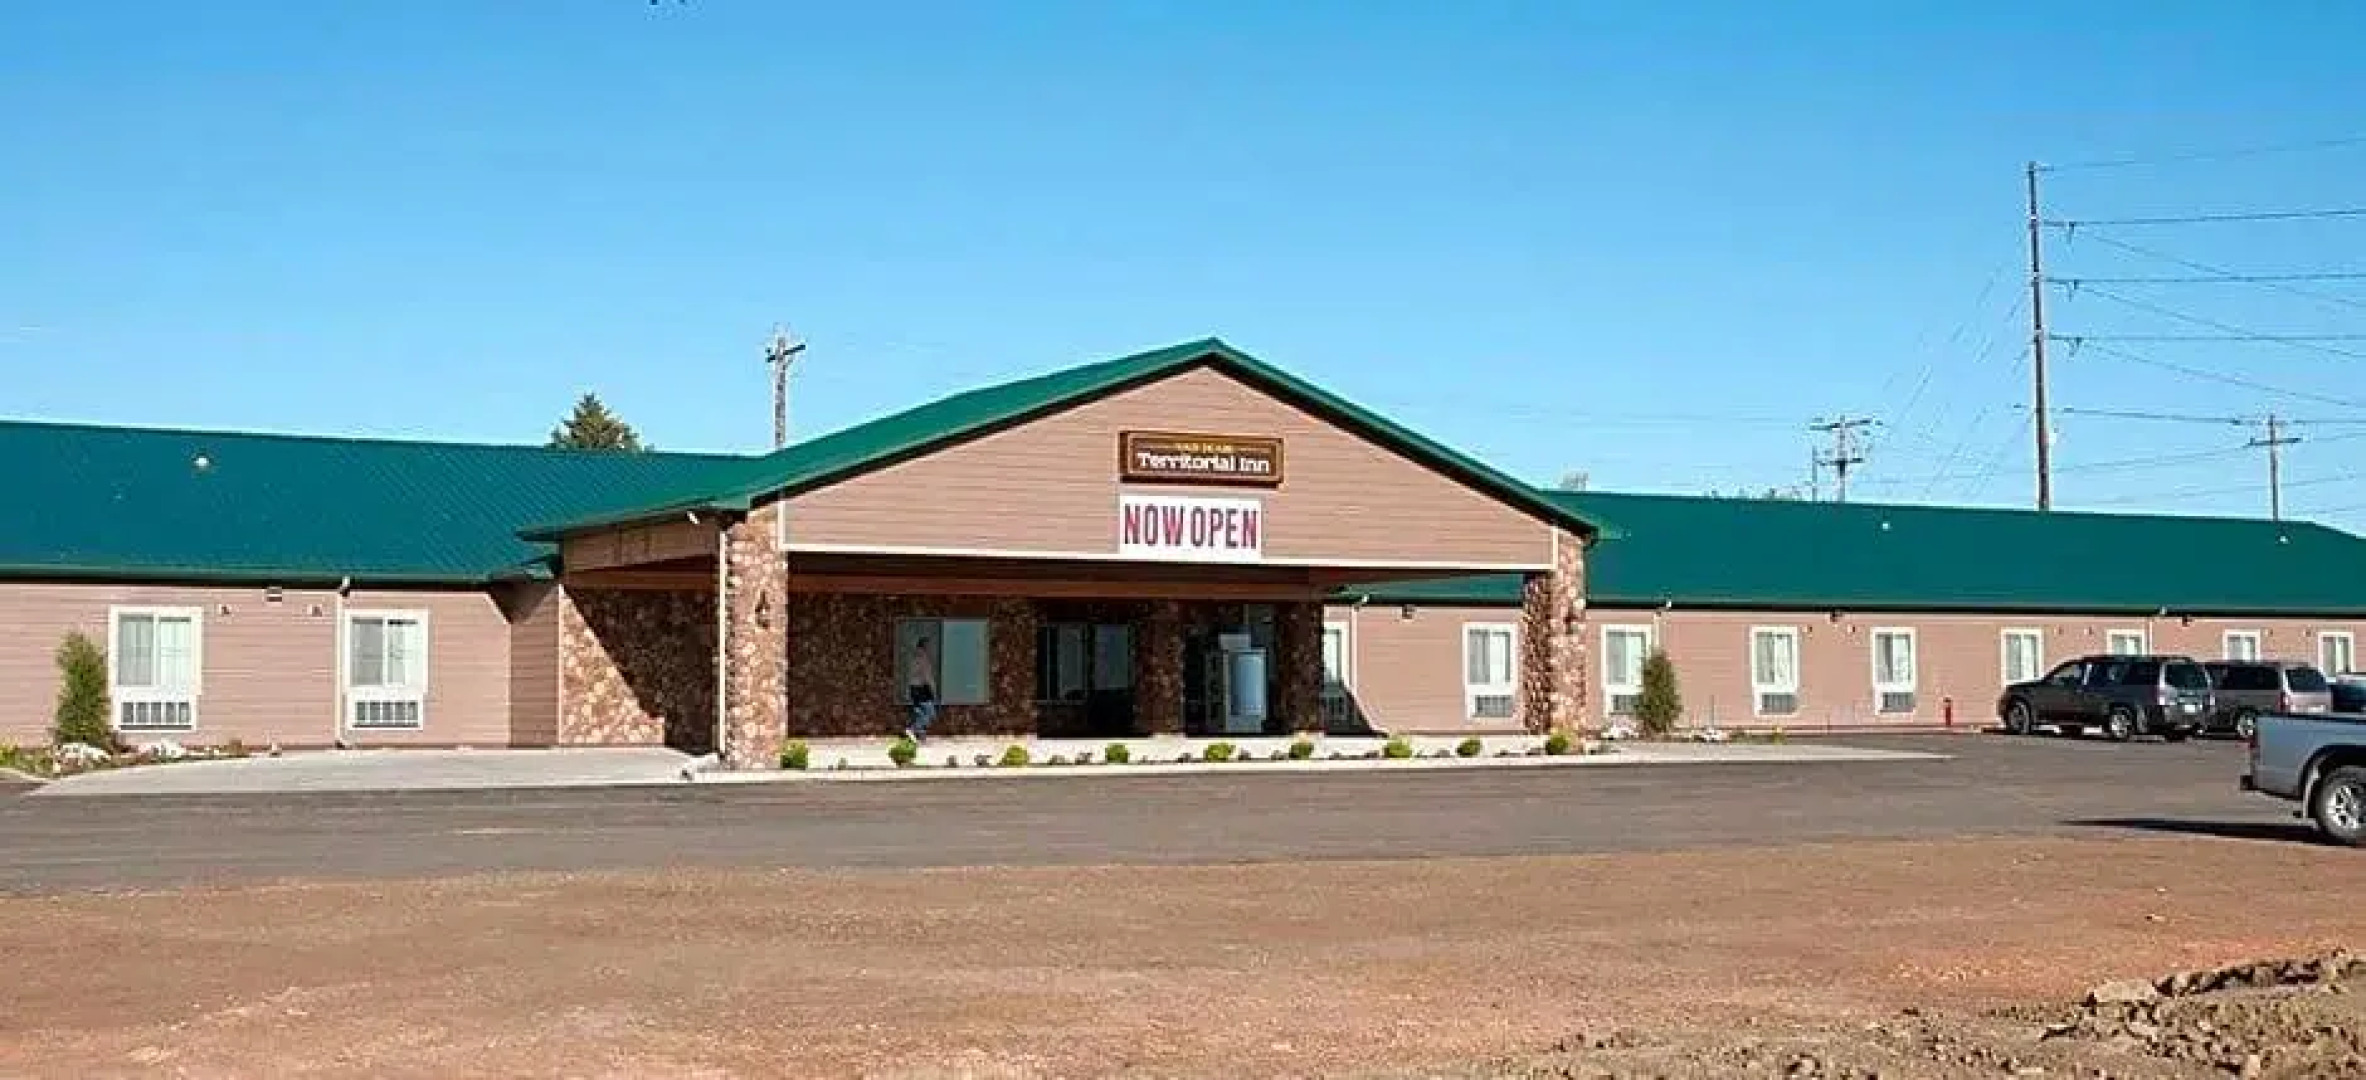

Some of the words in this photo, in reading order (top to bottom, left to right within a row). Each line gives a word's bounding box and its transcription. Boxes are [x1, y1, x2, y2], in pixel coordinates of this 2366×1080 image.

[1137, 452, 1235, 472] Territorial
[1240, 457, 1270, 473] Inn
[1124, 504, 1184, 546] NOW
[1190, 506, 1258, 549] OPEN
